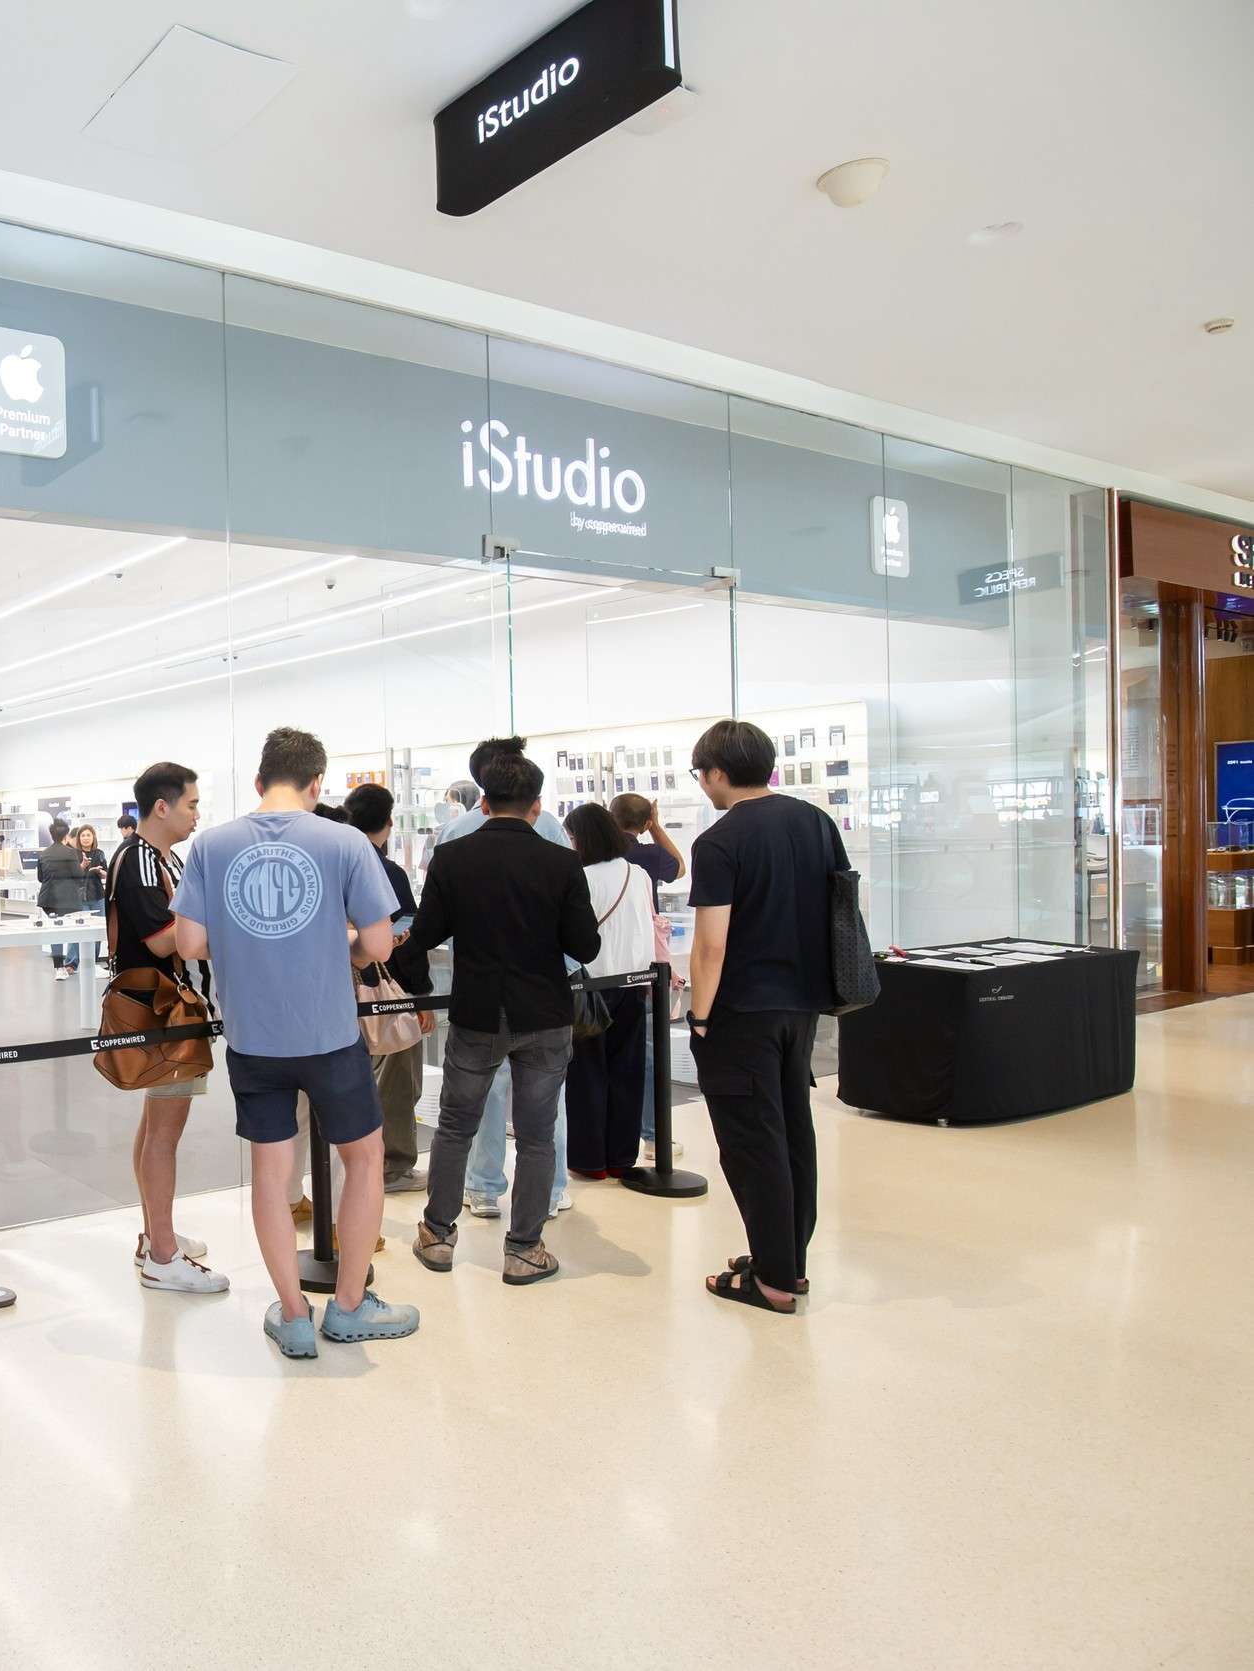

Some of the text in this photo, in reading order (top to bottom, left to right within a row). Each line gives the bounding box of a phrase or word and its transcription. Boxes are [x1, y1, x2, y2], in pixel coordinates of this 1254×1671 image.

[477, 57, 580, 144] iStudio
[0, 422, 48, 441] Partner
[460, 419, 646, 514] iStudio
[231, 848, 316, 932] MARITHE FRANCOIS GIRBAUD PARIS 1972
[100, 1035, 146, 1048] COPPERWIRED
